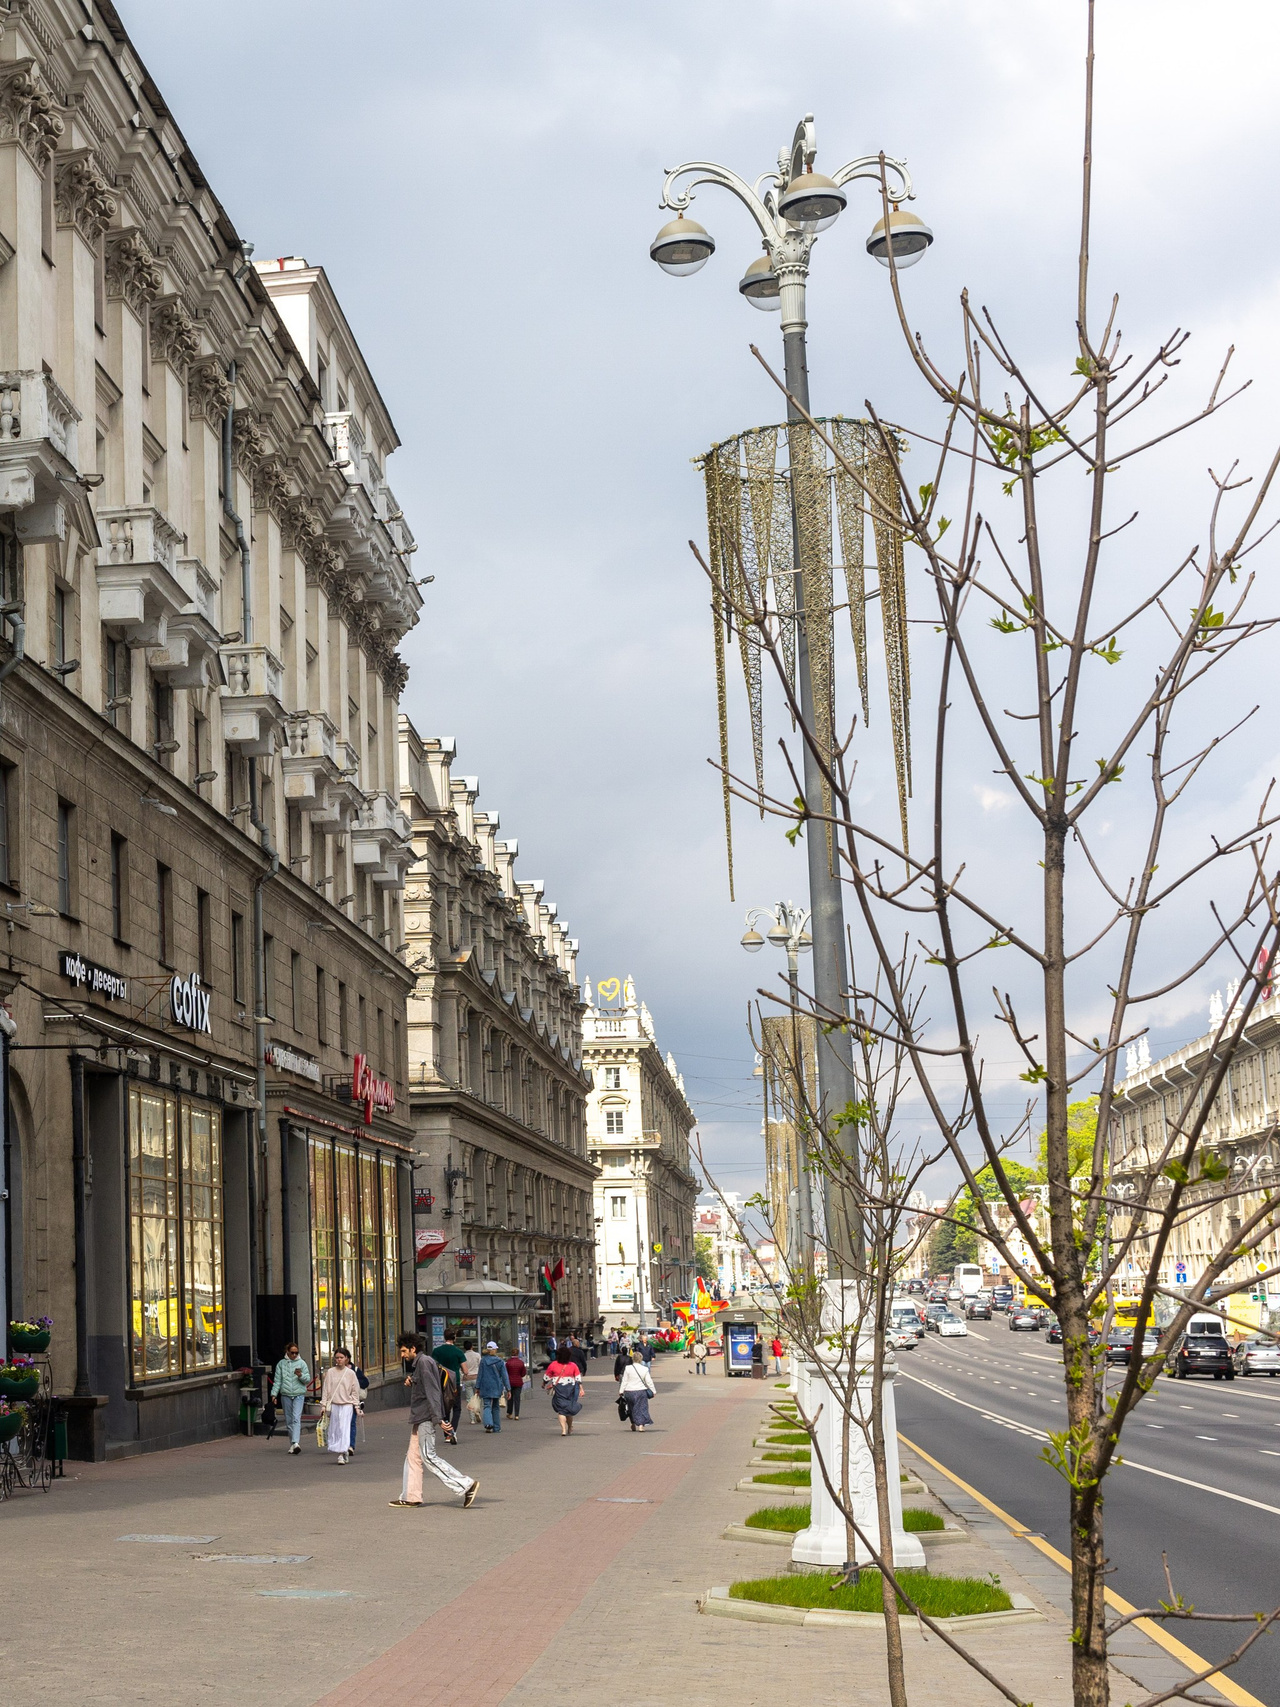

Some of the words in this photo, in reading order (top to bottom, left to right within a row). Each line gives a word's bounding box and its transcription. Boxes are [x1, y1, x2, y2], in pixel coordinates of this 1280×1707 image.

[65, 952, 87, 987] кофе
[92, 967, 127, 1001] десерты
[170, 972, 212, 1034] cofix
